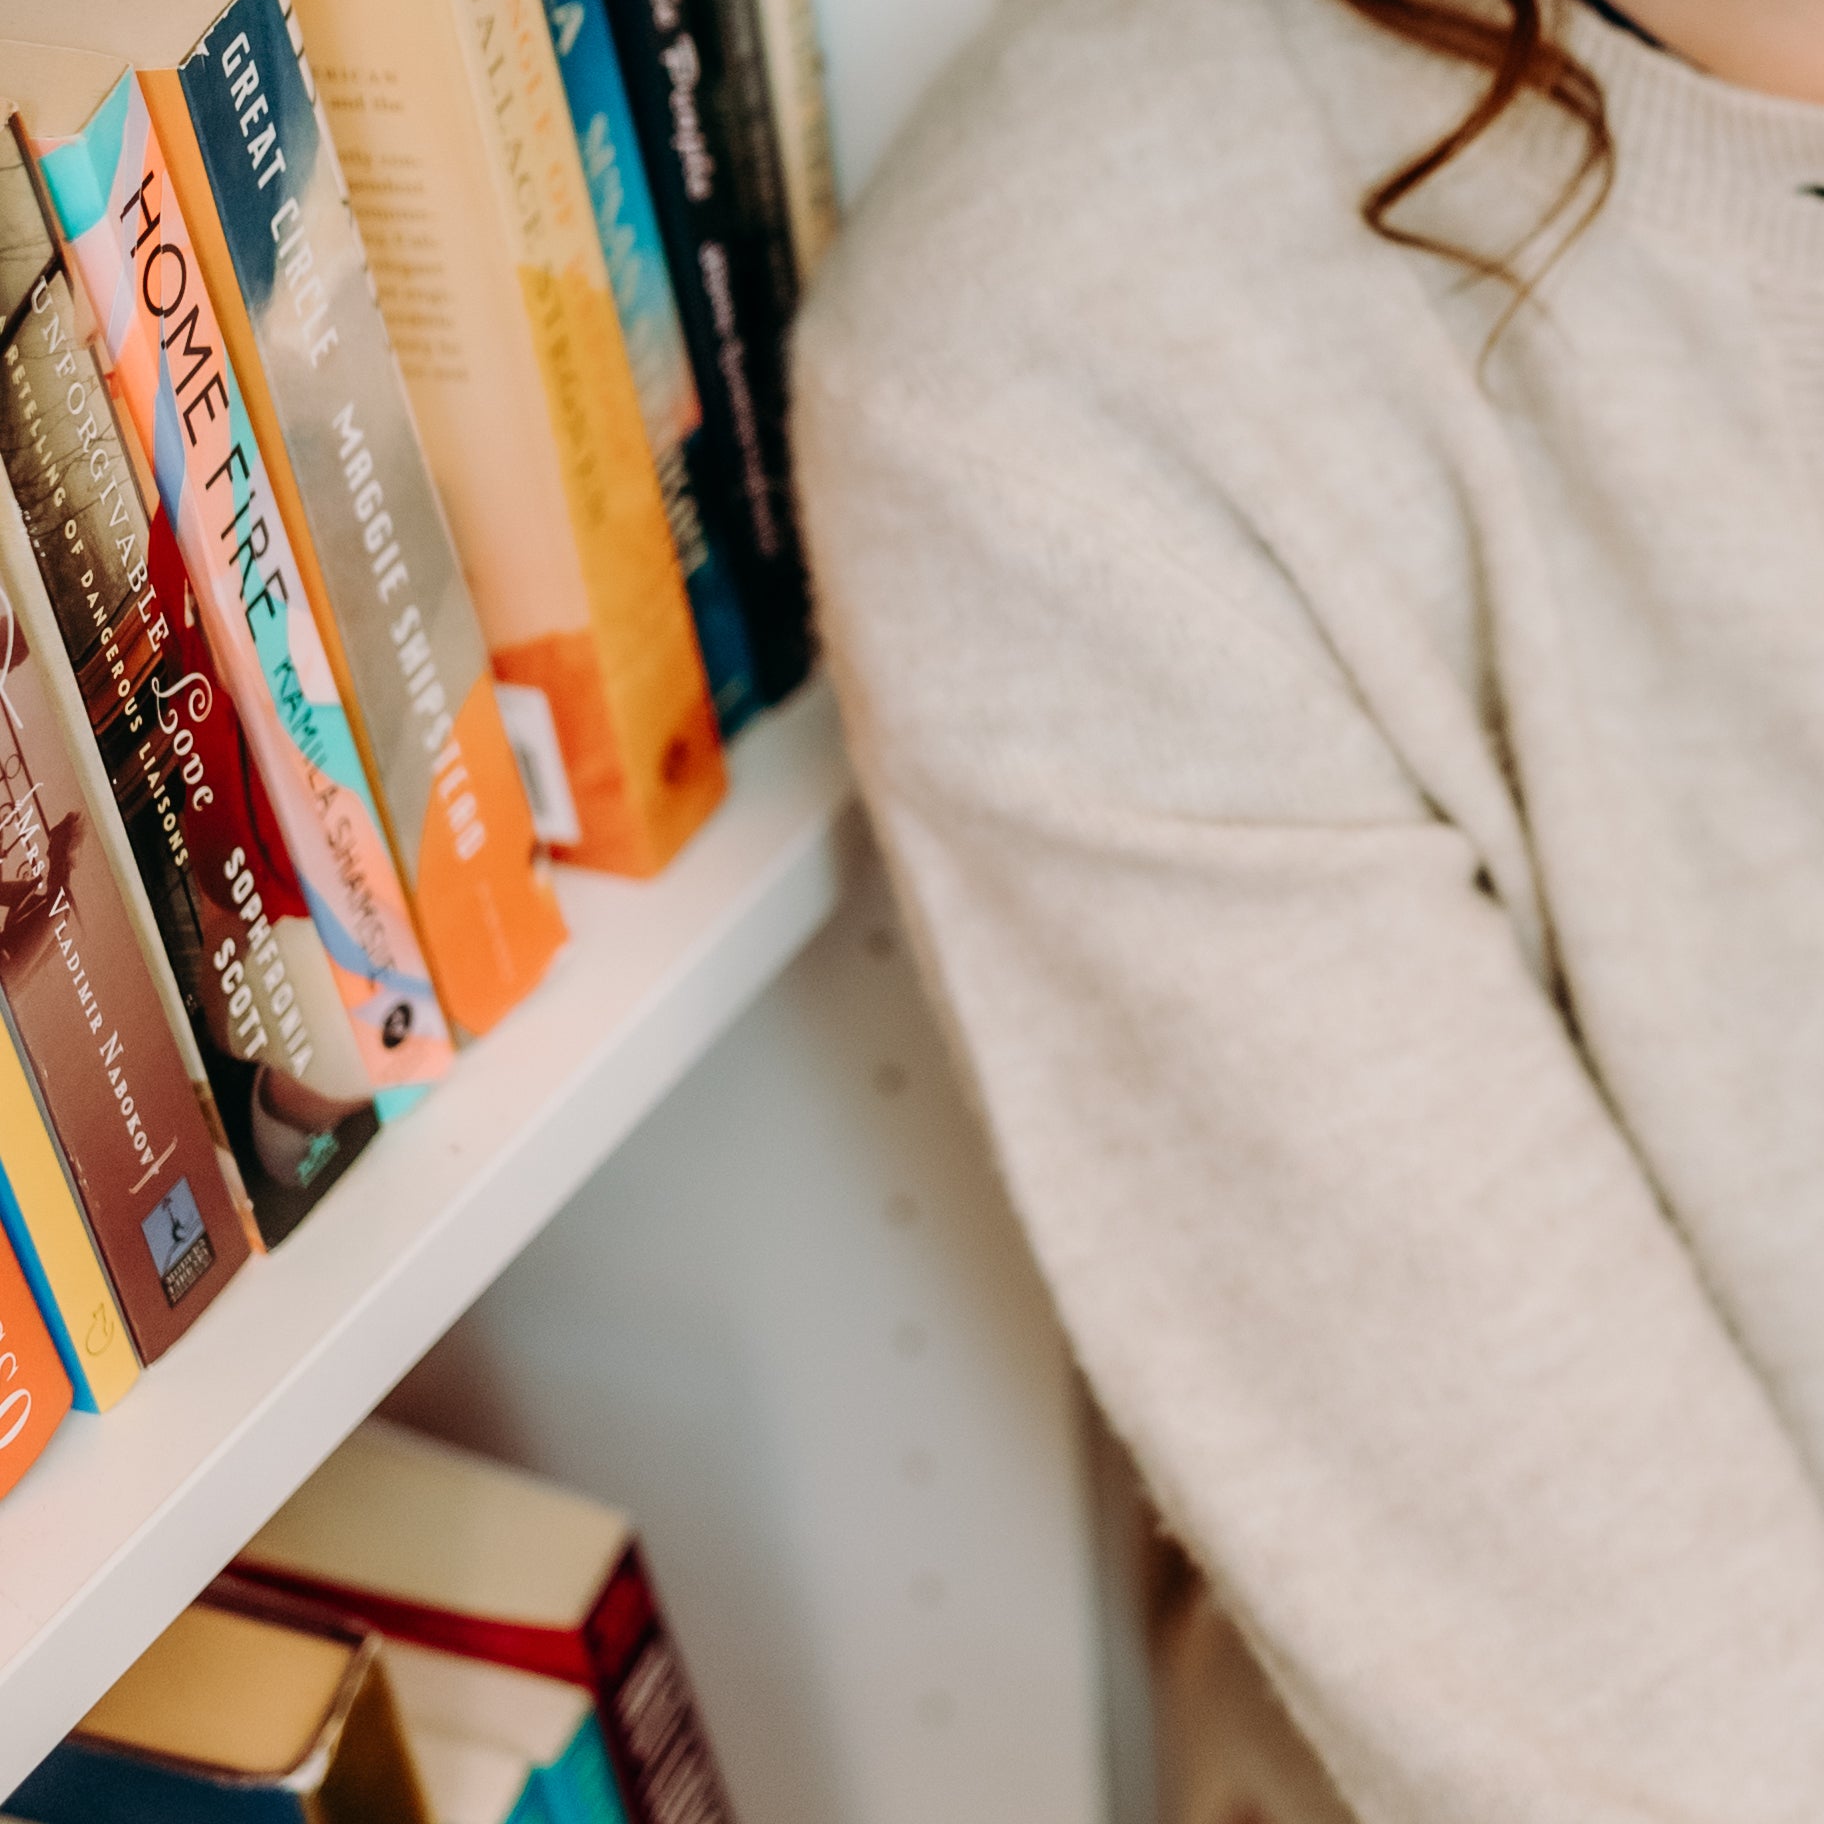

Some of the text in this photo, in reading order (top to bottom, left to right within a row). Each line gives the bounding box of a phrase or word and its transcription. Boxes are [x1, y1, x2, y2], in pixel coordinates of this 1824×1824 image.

[31, 275, 213, 812] UNFORGIVABLE Love
[120, 170, 229, 446] HOME
[205, 442, 289, 644] FIRE
[274, 655, 338, 814] KAMILA
[221, 31, 287, 190] GREAT
[270, 195, 339, 368] CIRCLE
[332, 402, 410, 604] MAGGIE
[5, 343, 189, 868] RETELLING OF DANGEROUS LIAISONS
[213, 937, 268, 1059] SCOTT
[224, 846, 314, 1077] SOPHFRONIA
